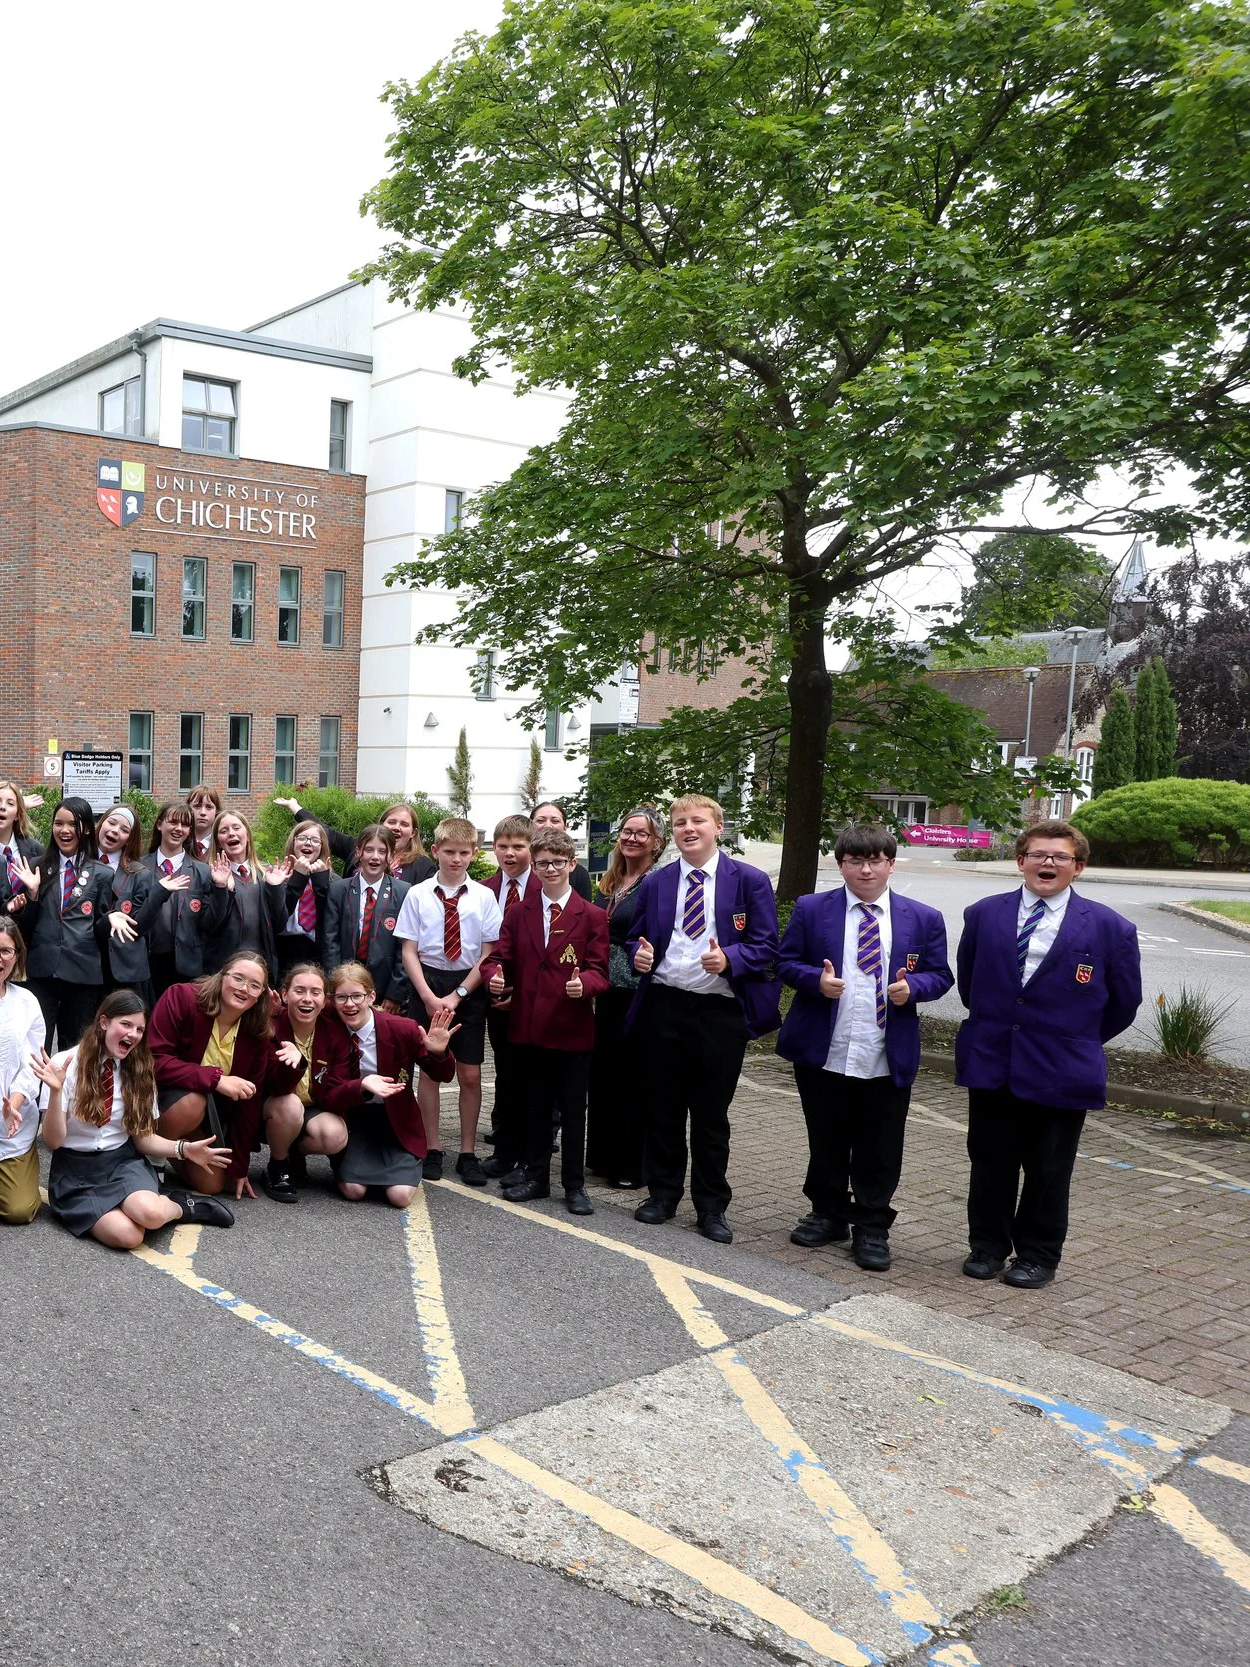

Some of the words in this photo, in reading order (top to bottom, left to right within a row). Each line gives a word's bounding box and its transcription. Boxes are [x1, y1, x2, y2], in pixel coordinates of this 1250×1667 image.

[156, 475, 285, 504] UNIVERSITY
[296, 493, 318, 508] OF
[155, 496, 317, 539] CHICHESTER
